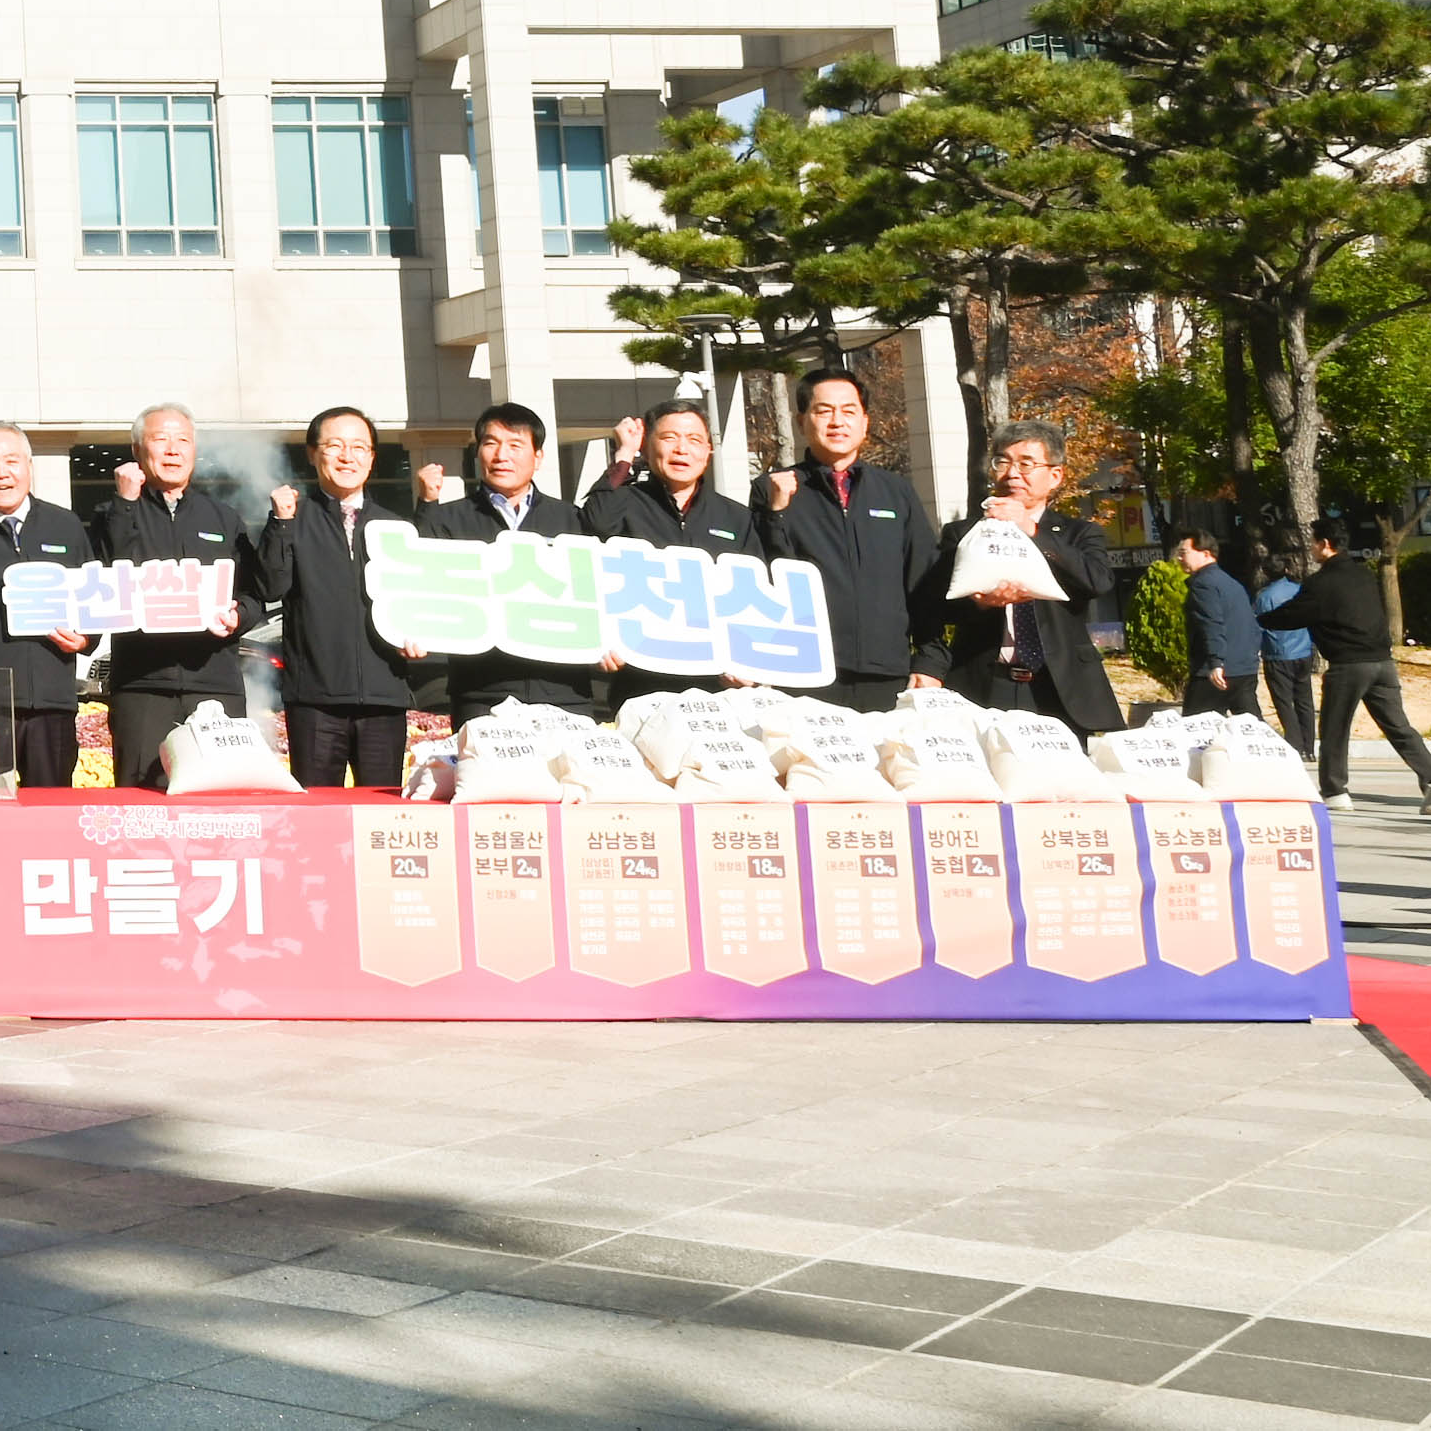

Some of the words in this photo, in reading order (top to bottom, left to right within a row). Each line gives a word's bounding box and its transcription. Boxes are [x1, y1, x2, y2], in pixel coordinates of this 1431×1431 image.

[7, 563, 230, 631] 울산쌀!
[378, 530, 824, 676] 농심천심
[124, 806, 168, 820] 2028
[370, 831, 439, 850] 울산시청
[474, 831, 543, 850] 농협울산
[587, 831, 656, 850] 삼남농협
[711, 831, 779, 850] 청량농협
[826, 830, 894, 849] 웅촌농협
[929, 830, 979, 849] 방어진
[1041, 829, 1109, 849] 상북농협
[1154, 827, 1222, 847] 농소농협
[1247, 826, 1313, 845] 온산농협
[475, 857, 508, 875] 본부
[931, 856, 963, 875] 농협
[22, 859, 265, 936] 만들기
